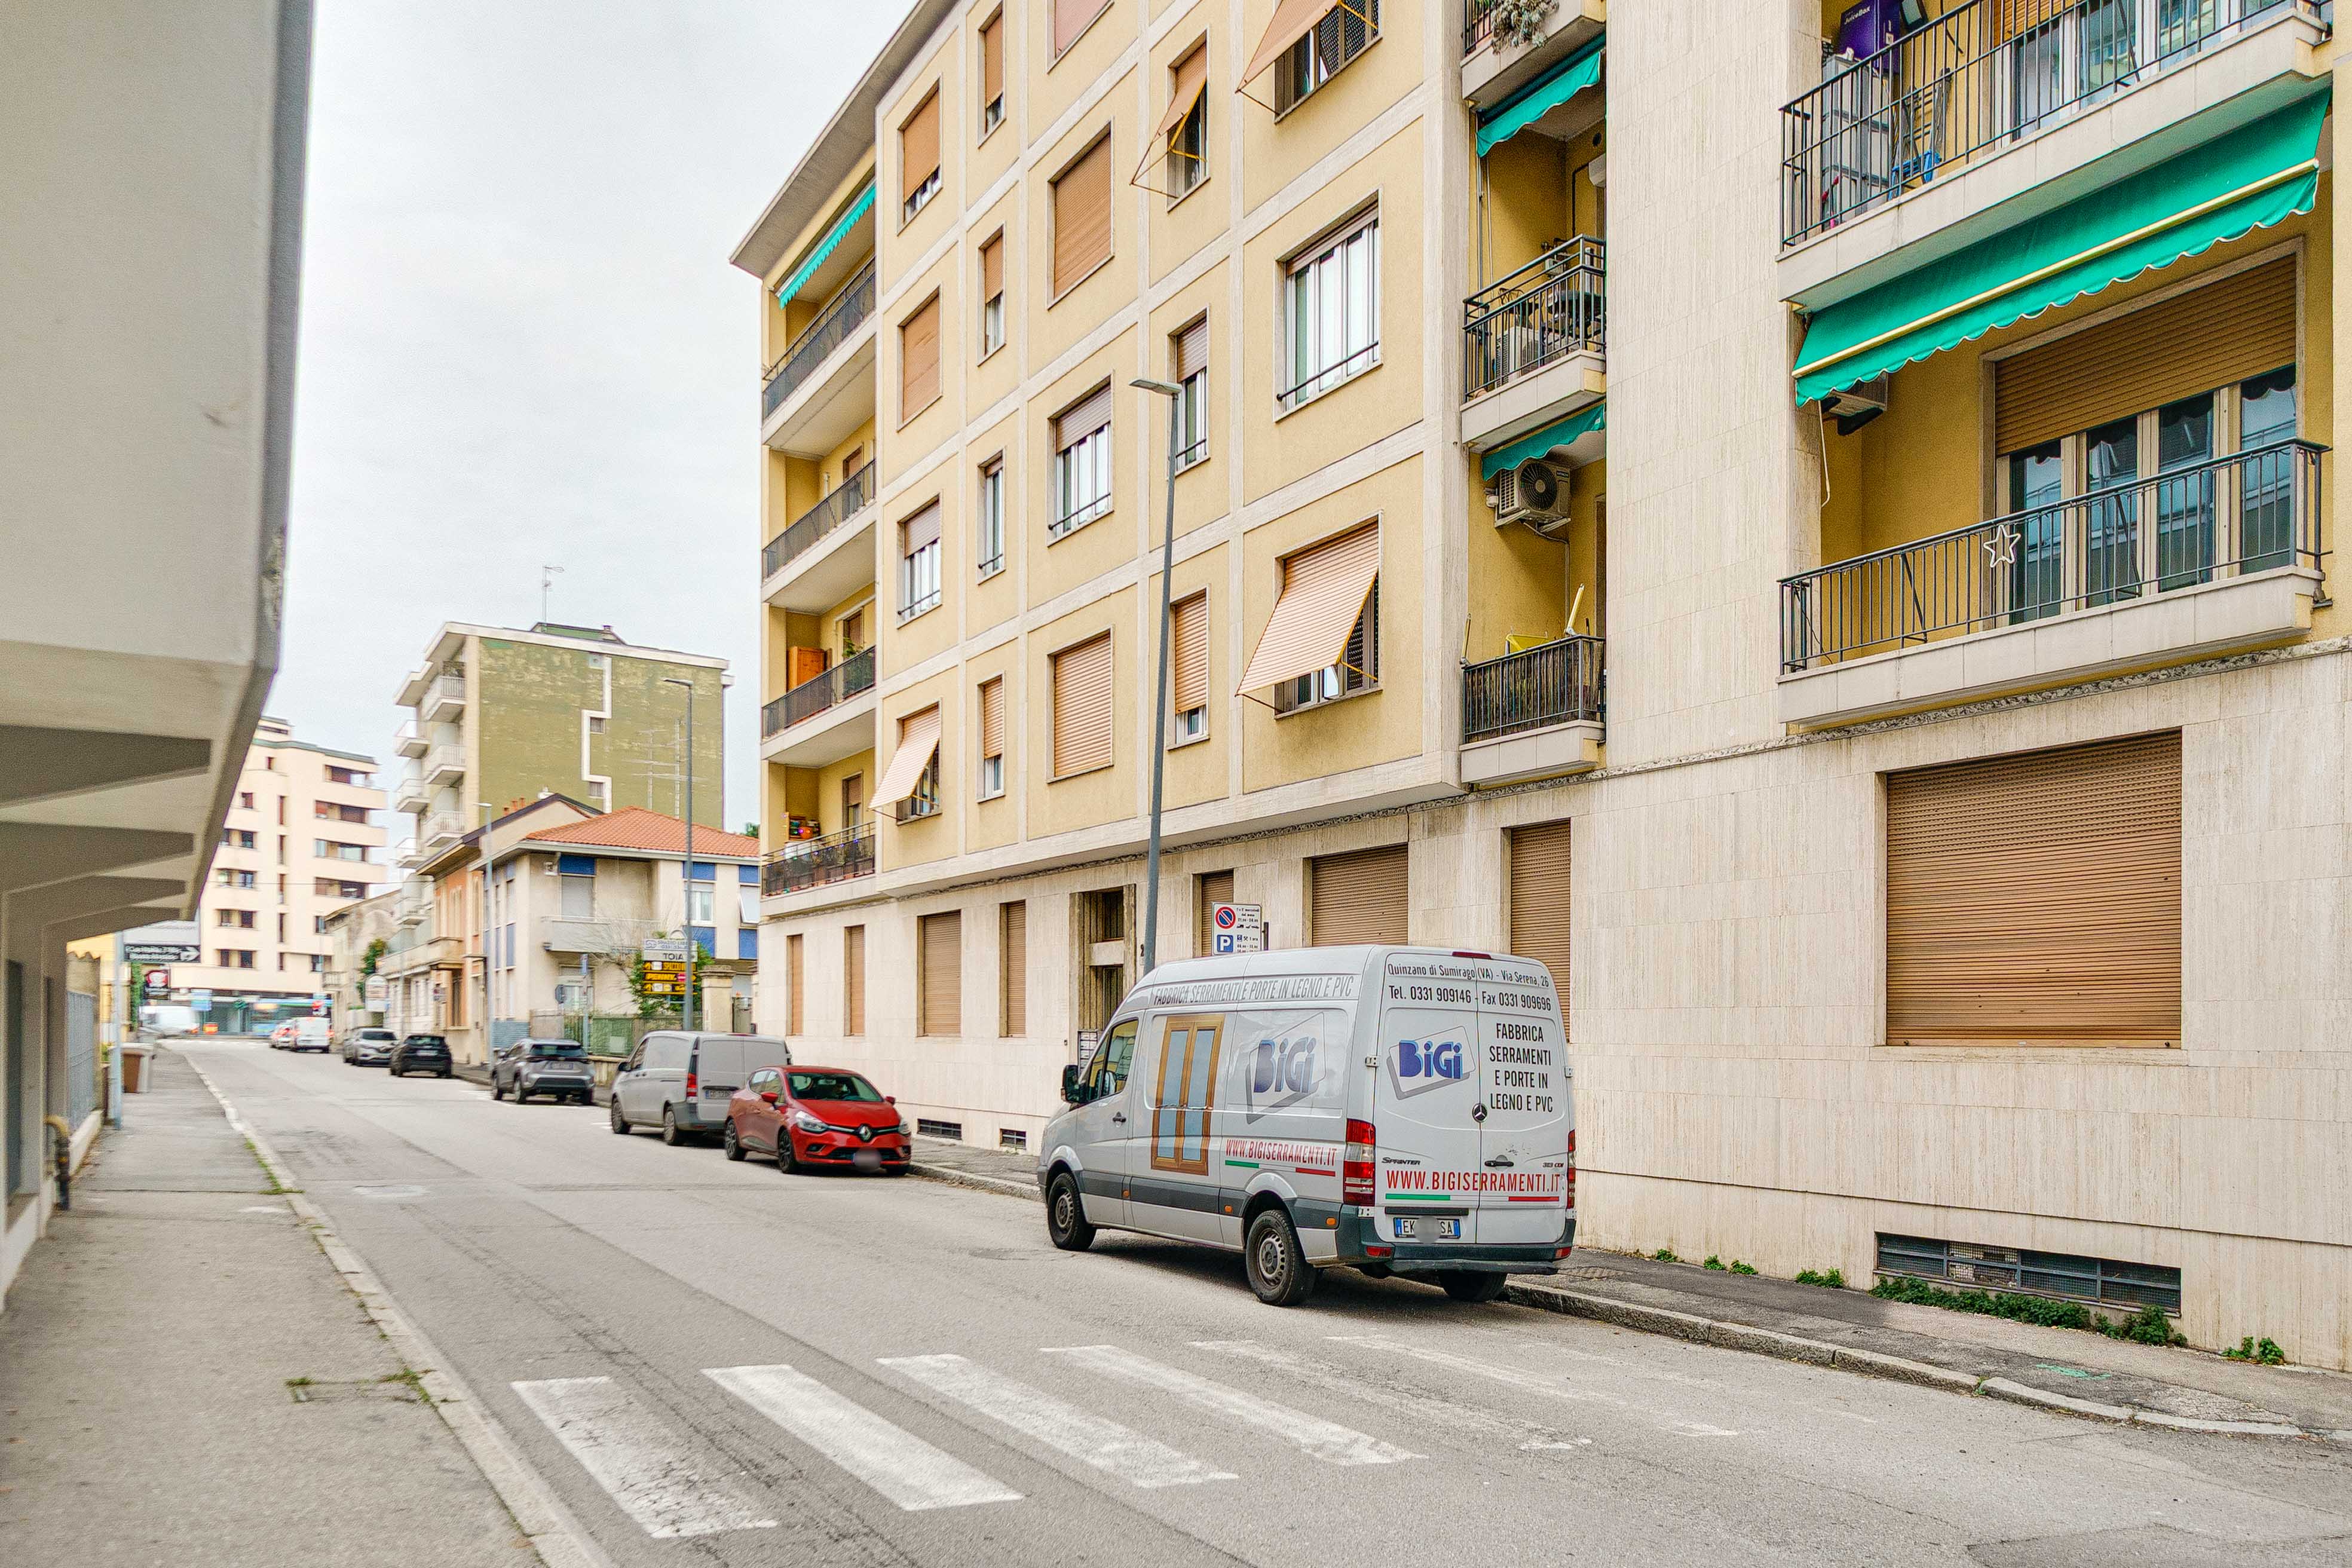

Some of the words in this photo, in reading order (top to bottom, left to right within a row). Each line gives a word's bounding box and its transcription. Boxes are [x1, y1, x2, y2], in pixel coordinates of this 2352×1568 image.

[1388, 963, 1427, 976] Quinzano
[1429, 964, 1437, 976] di
[1440, 965, 1476, 980] Sumirago
[1477, 968, 1493, 980] (VA)
[1500, 970, 1513, 982] Via
[1541, 975, 1549, 987] 26
[1153, 985, 1189, 1005] FABBRICA
[1190, 980, 1242, 1003] SERRAMENTI
[1241, 981, 1250, 1000] E
[1250, 979, 1279, 1000] PORTE
[1278, 978, 1291, 999] IN
[1291, 978, 1324, 999] LEGNO
[1324, 976, 1333, 997] E
[1332, 975, 1354, 997] PVC
[1389, 985, 1407, 1000] Tel.
[1410, 985, 1432, 1001] 0331
[1437, 987, 1471, 1003] 909146
[1482, 991, 1497, 1006] Fax
[1499, 993, 1518, 1007] 0331
[1521, 994, 1551, 1011] 909696
[1496, 1022, 1544, 1042] FABBRICA
[1489, 1046, 1551, 1066] SERRAMENTI
[1494, 1069, 1500, 1086] E
[1504, 1070, 1535, 1088] PORTE
[1538, 1073, 1548, 1089] IN
[1490, 1093, 1523, 1111] LEGNO
[1526, 1095, 1532, 1111] E
[1536, 1095, 1553, 1113] PVC
[1225, 1138, 1337, 1166] WWW.BIGISERRAMENTI.IT
[1386, 1170, 1560, 1192] WWW.BIGISERRAMENTI.IT
